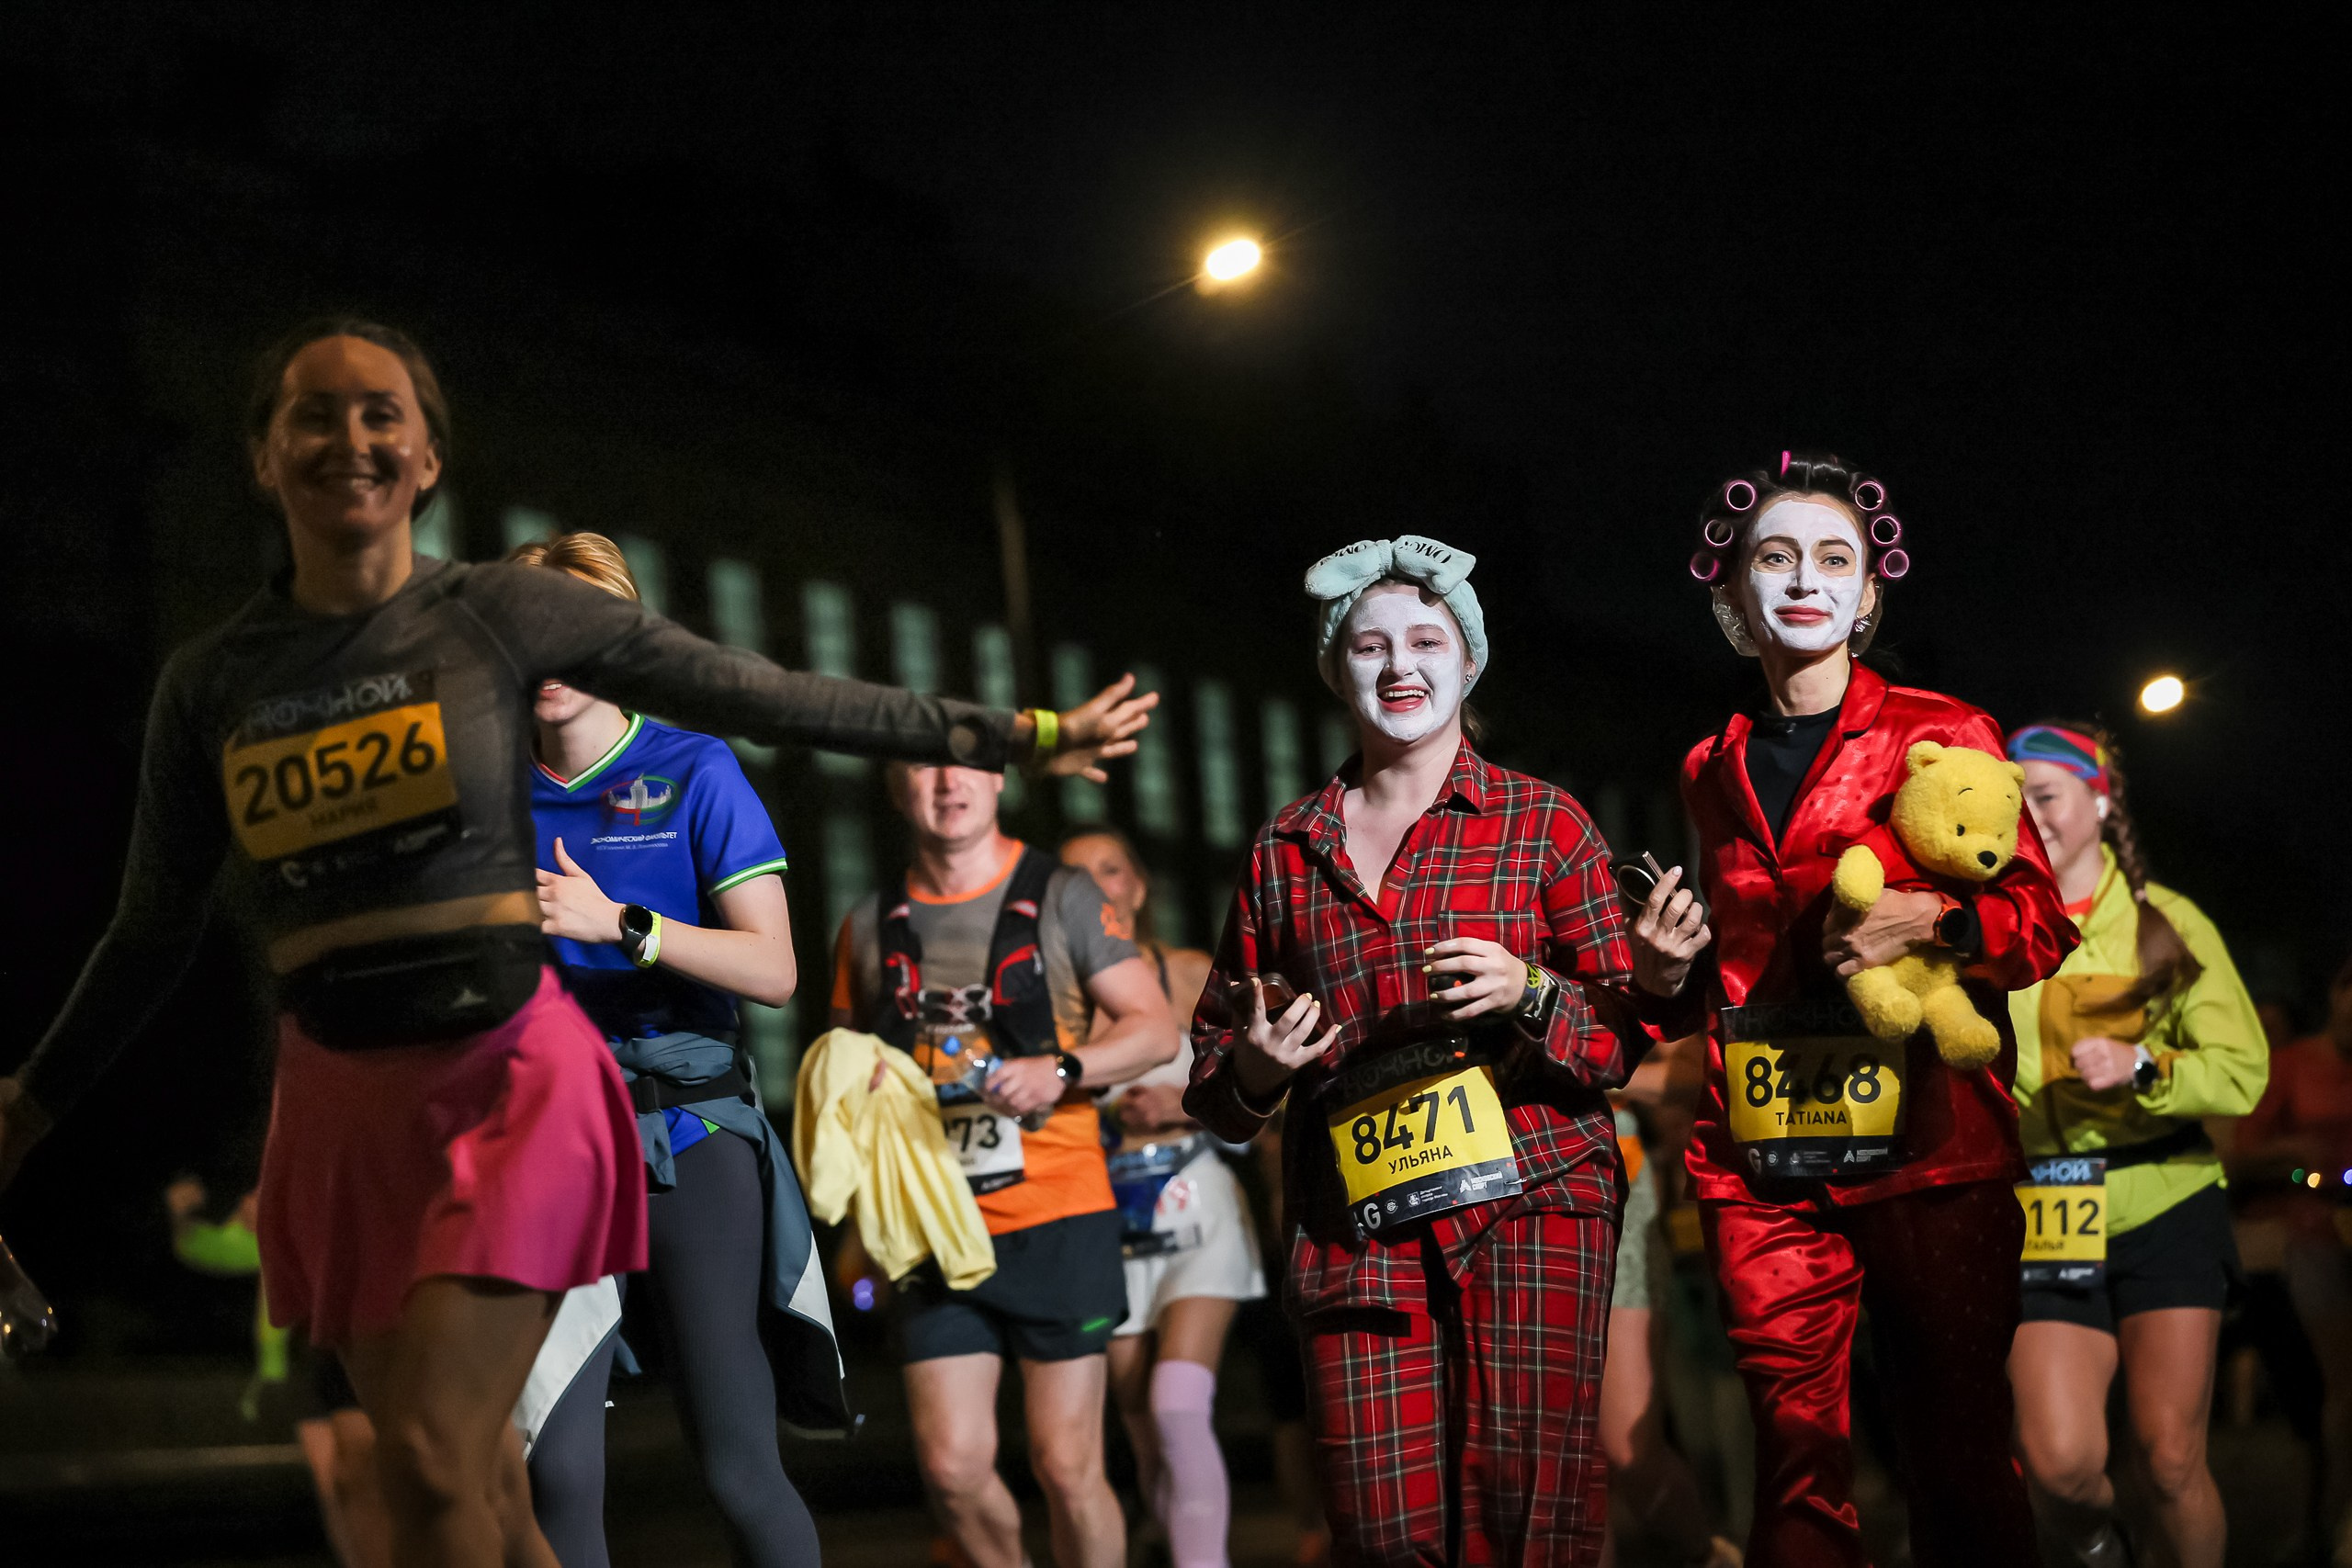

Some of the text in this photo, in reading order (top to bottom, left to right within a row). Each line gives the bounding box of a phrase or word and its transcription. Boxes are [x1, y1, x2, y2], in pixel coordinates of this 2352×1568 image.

[235, 721, 436, 827] 20526
[1746, 1054, 1882, 1108] 8468
[1351, 1085, 1476, 1165] 8471
[1775, 1110, 1848, 1126] TATIANA
[1388, 1145, 1453, 1175] УЛЬЯНА
[1363, 1202, 1381, 1229] G
